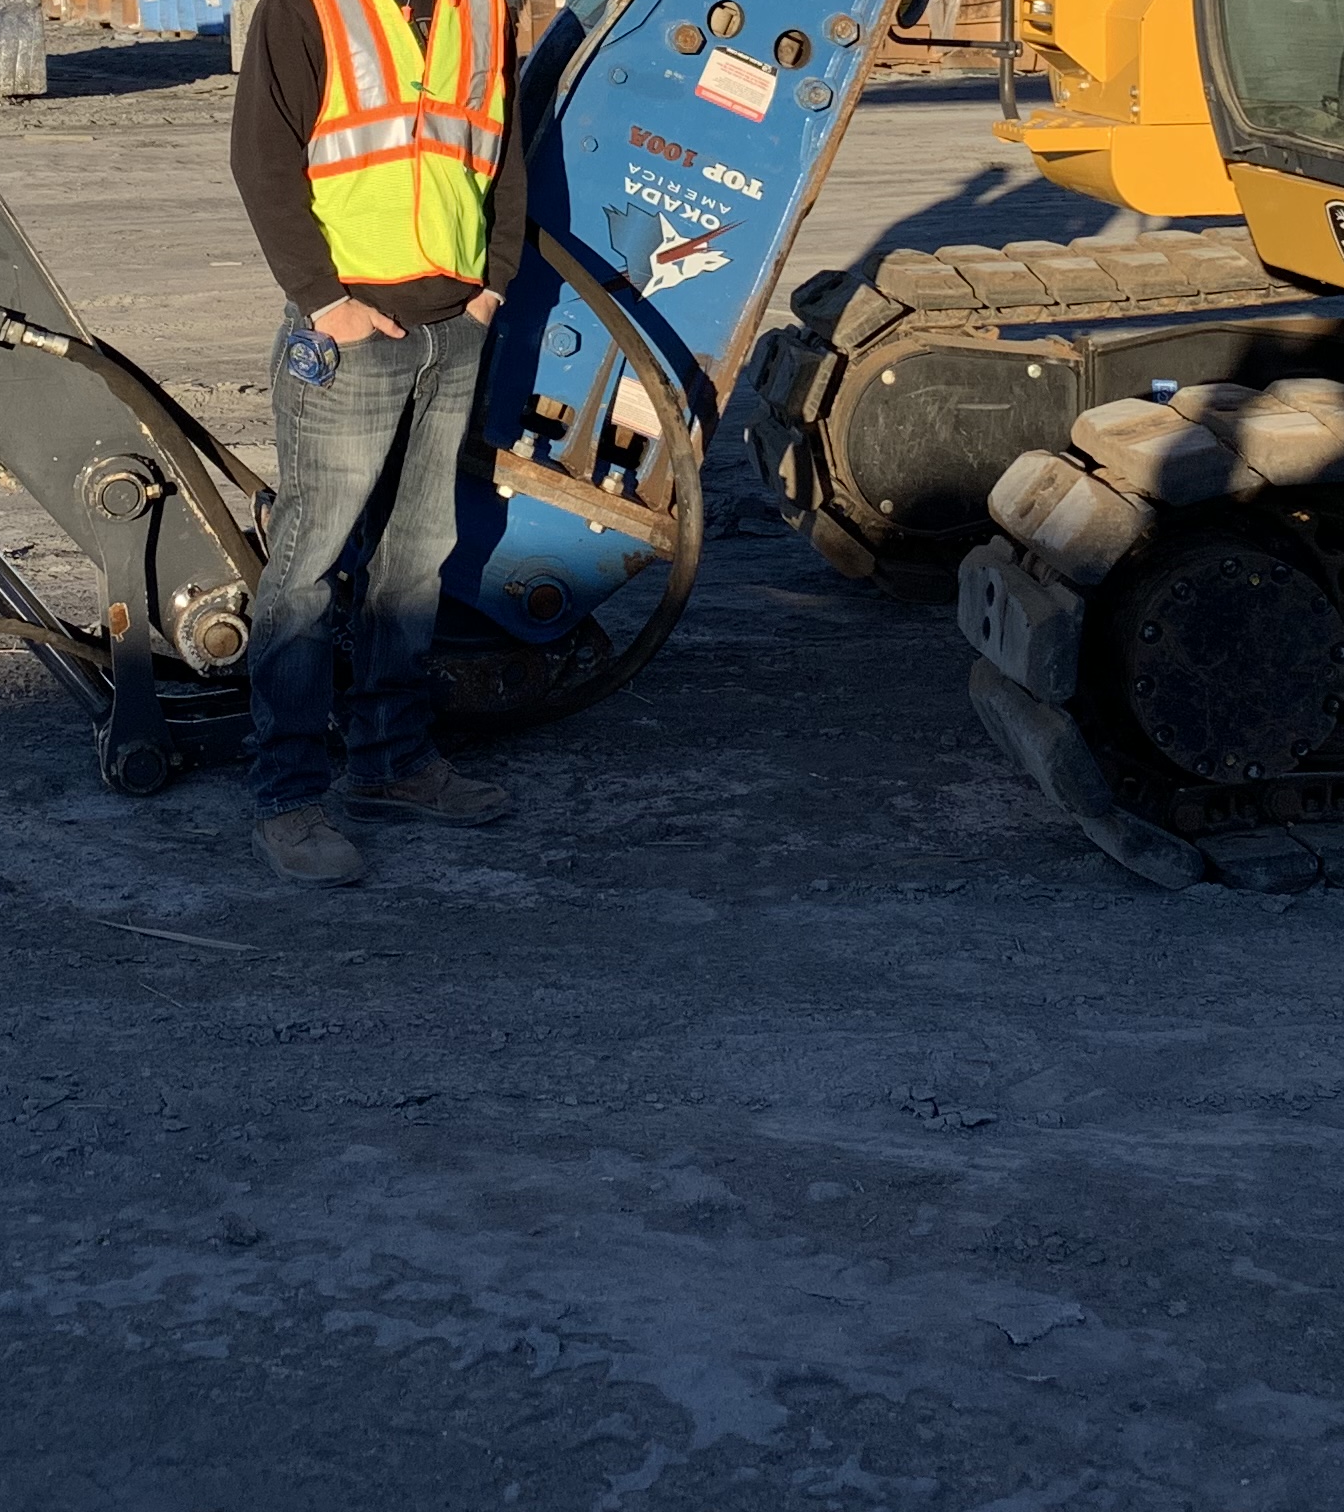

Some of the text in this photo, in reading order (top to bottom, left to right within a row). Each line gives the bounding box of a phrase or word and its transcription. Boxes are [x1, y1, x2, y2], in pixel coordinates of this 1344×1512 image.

[629, 125, 765, 201] TOP 100A
[629, 162, 732, 214] AMERICA
[624, 176, 721, 230] OKADA
